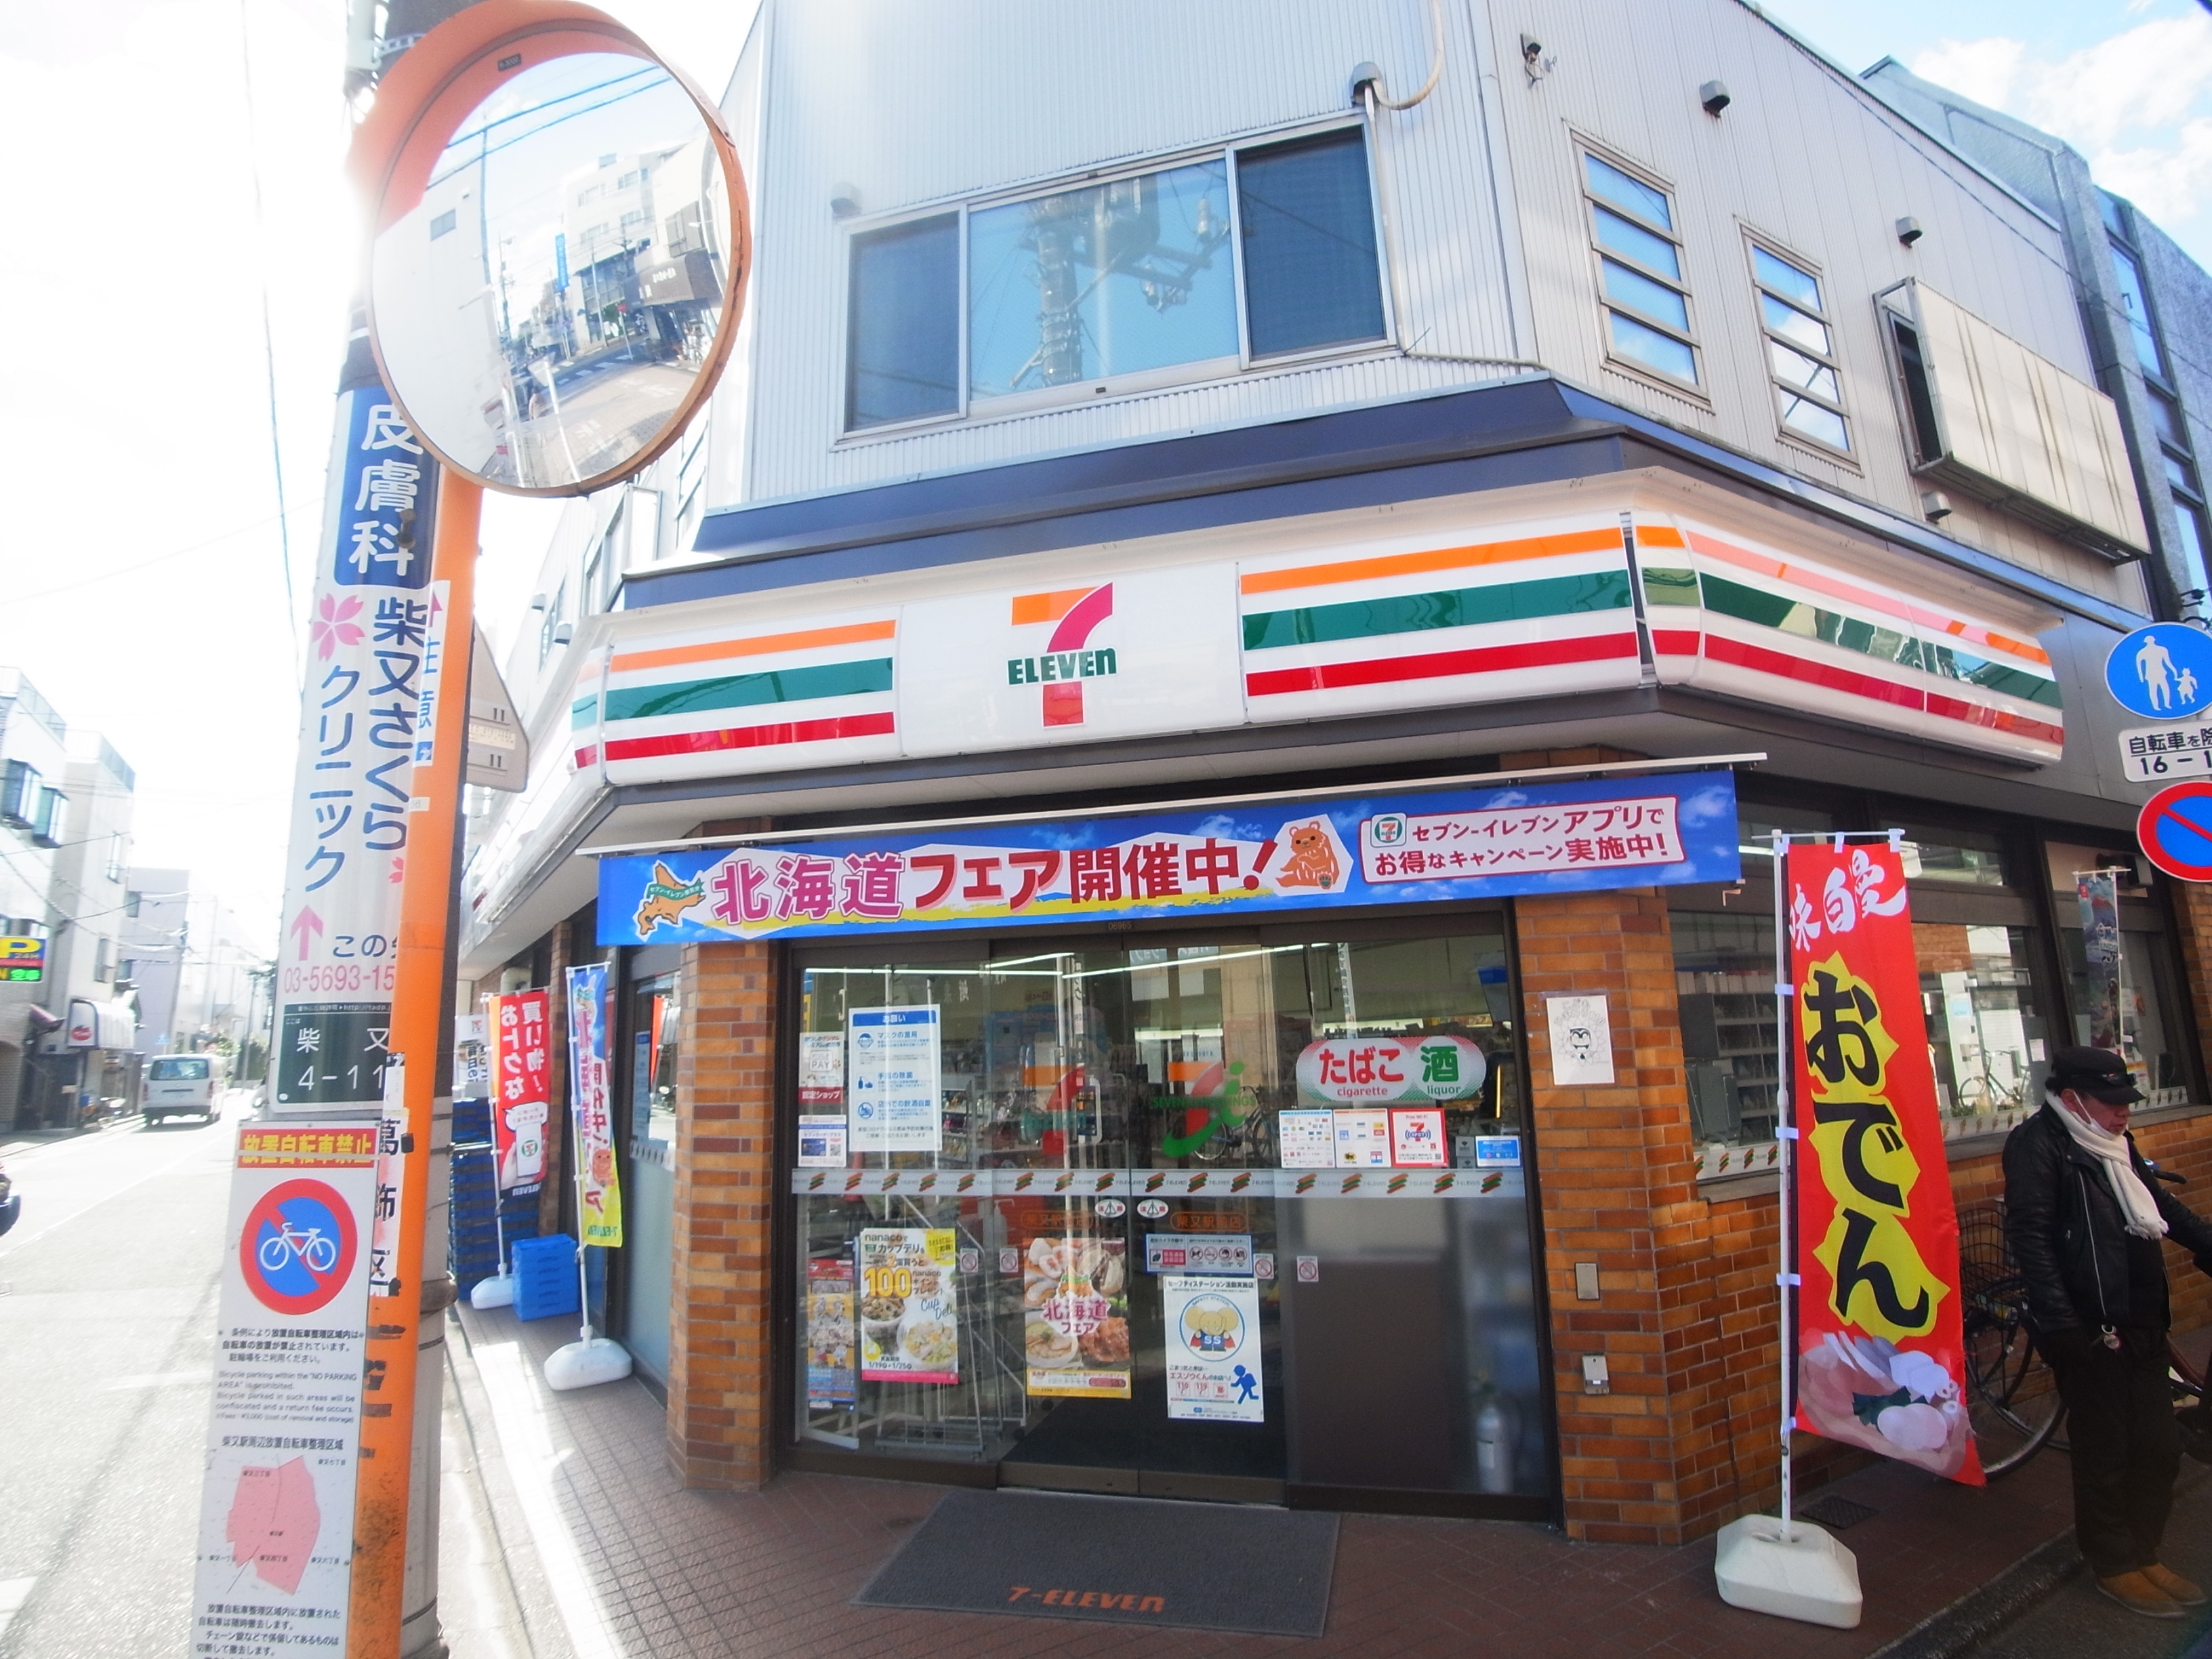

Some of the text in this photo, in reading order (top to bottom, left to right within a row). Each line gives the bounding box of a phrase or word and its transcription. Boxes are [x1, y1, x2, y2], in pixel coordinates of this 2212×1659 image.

[348, 403, 424, 576] 皮膚科
[1012, 582, 1113, 726] 7
[363, 596, 428, 851] 柴又さくら
[305, 665, 360, 893] クリニック
[1375, 833, 1668, 877] お得なキャンペーン実施中!
[712, 838, 1279, 924] 北海道フェア開催中!
[1789, 848, 1906, 951] 味自慢
[1108, 921, 1132, 930] 06965
[284, 964, 395, 994] 03-5693-15
[882, 1014, 906, 1023] お願い
[811, 1061, 830, 1069] PAY
[1319, 1045, 1459, 1084] たばこ 酒
[1336, 1085, 1461, 1098] cigarette liquor
[241, 1134, 372, 1165] 放置自転車禁止
[1803, 969, 1929, 1328] おでん
[1176, 1215, 1242, 1229] 柴又駅前店
[864, 1267, 912, 1298] 100
[920, 1298, 941, 1312] Cup
[935, 1302, 953, 1320] Deli
[1043, 1298, 1109, 1322] 北海道
[1061, 1322, 1096, 1334] フェア
[1204, 1335, 1221, 1345] SS
[218, 1370, 245, 1380] Bicycle
[246, 1371, 272, 1380] parking
[1177, 1381, 1189, 1389] 110
[1195, 1382, 1208, 1390] 119
[216, 1391, 245, 1400] Bicycle
[216, 1402, 261, 1410] confiscated
